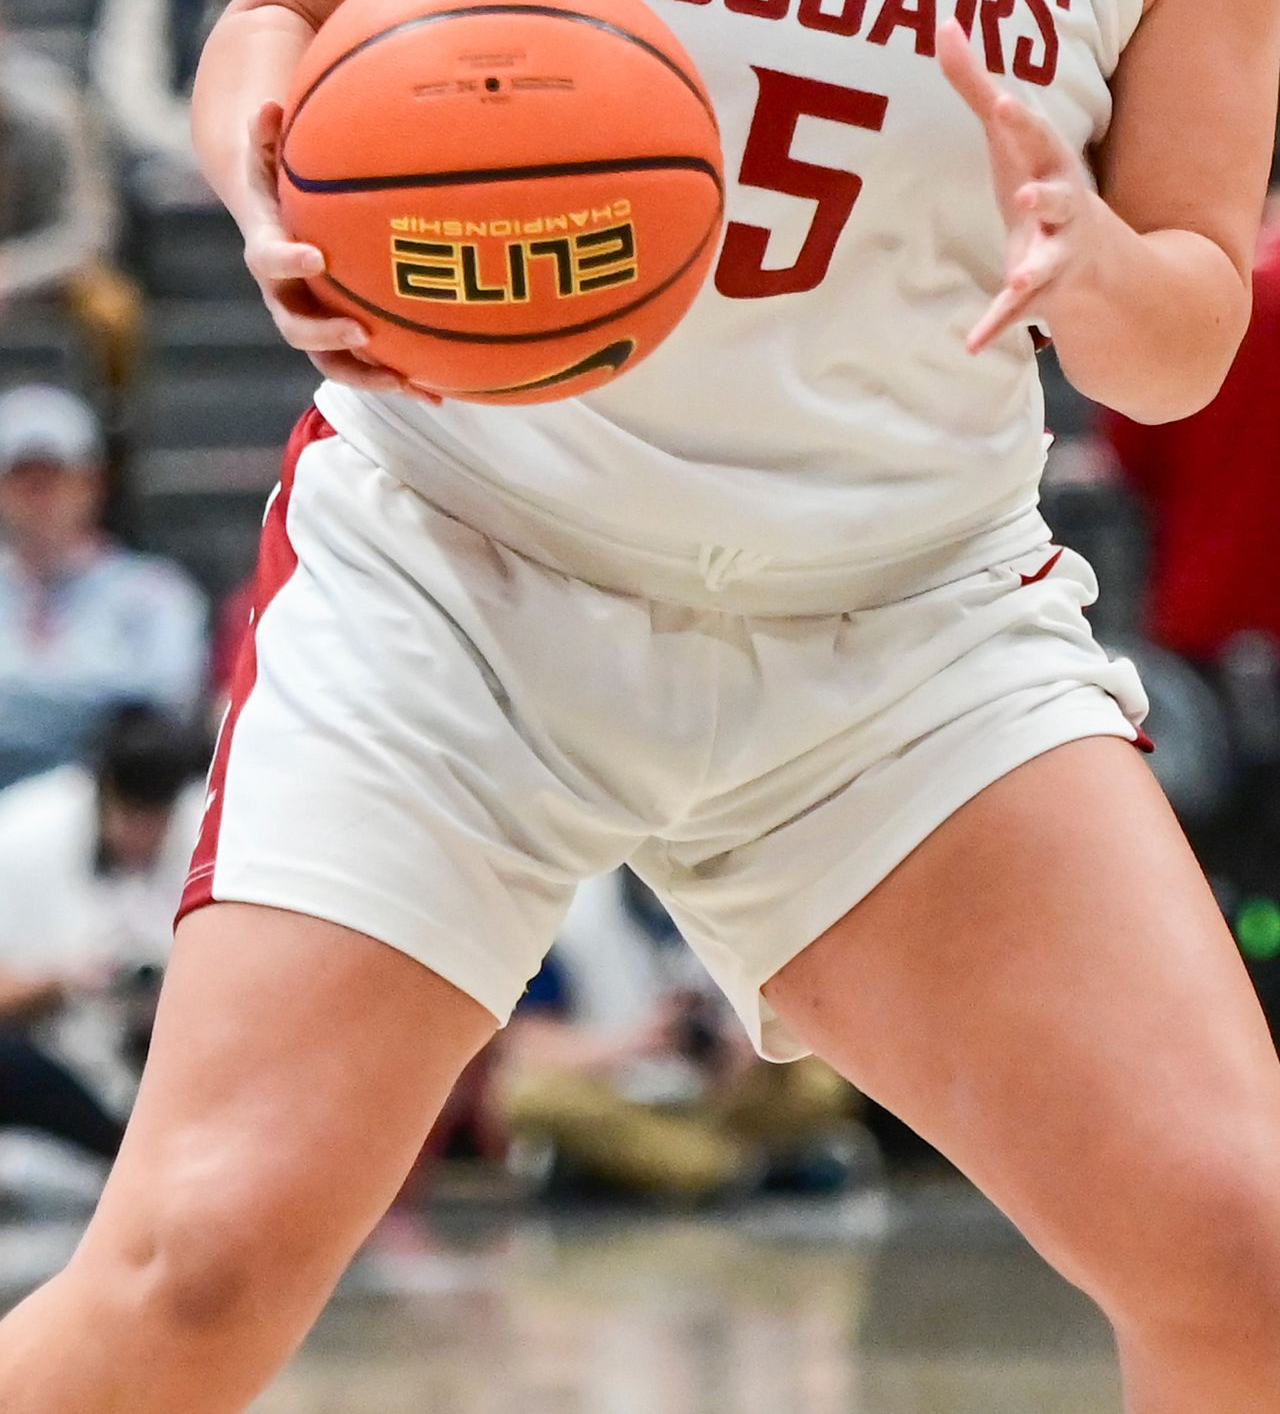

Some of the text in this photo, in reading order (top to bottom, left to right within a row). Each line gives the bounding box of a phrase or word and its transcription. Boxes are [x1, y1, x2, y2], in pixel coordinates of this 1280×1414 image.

[390, 198, 632, 237] CHAMPIONSHIP
[714, 64, 889, 299] 5
[391, 220, 638, 304] ELITE
